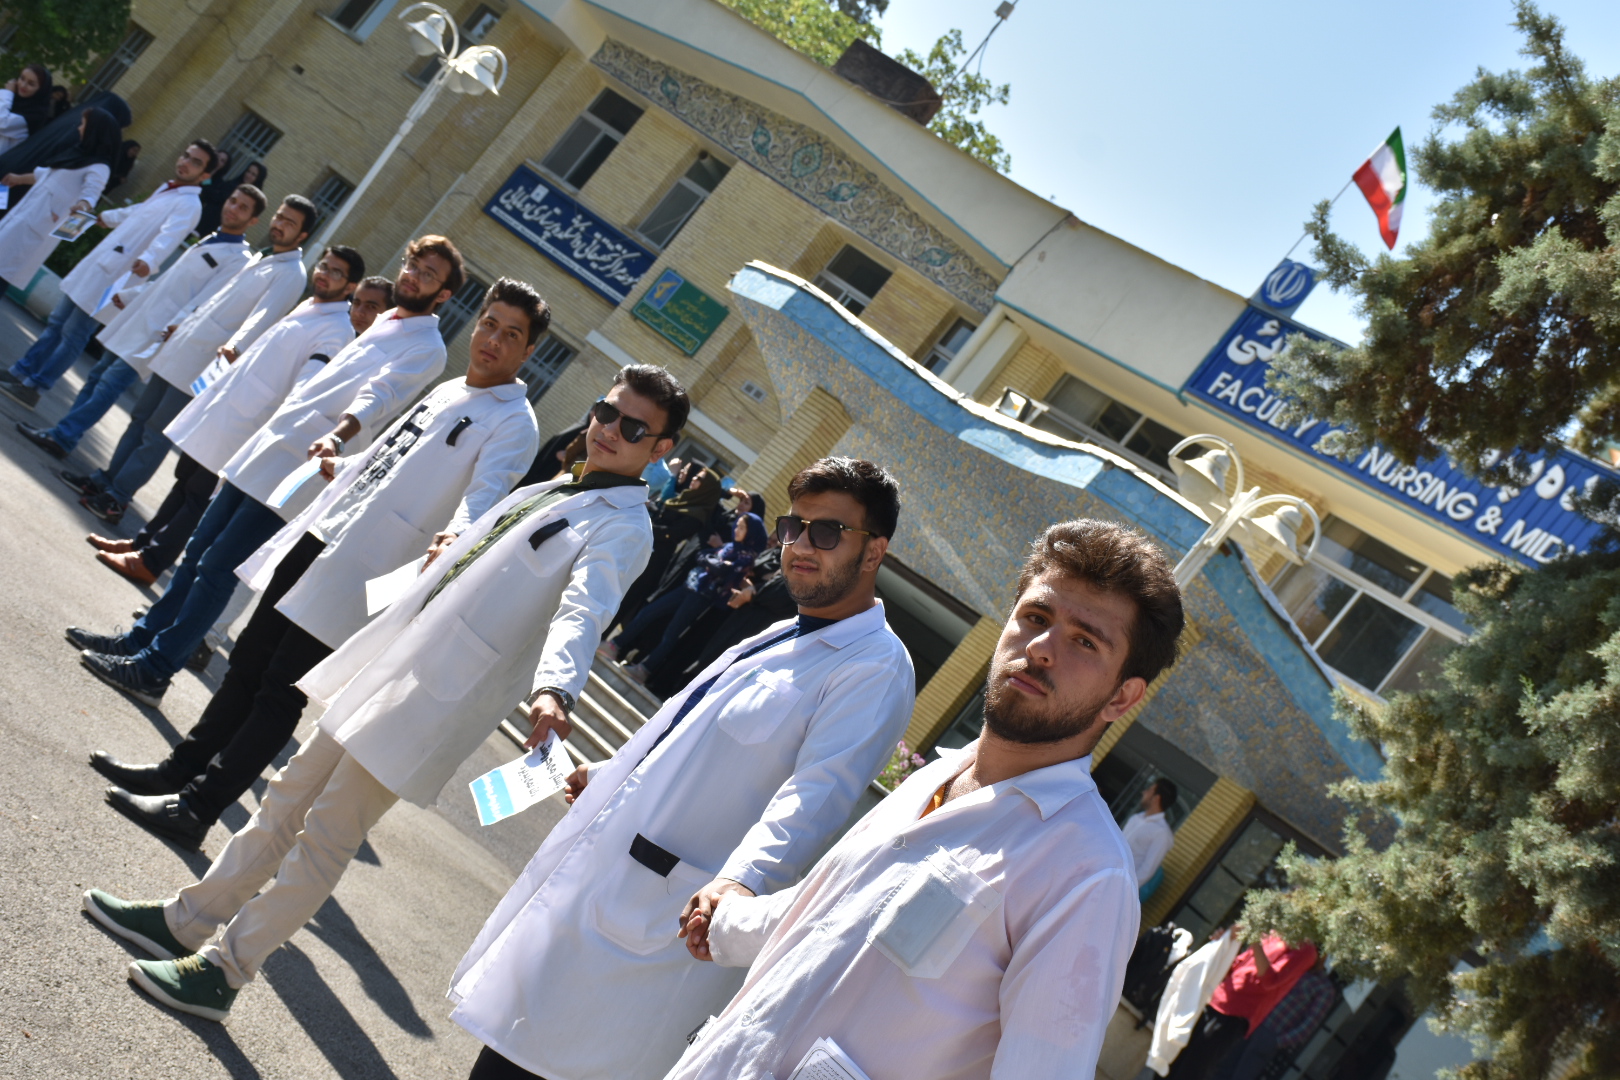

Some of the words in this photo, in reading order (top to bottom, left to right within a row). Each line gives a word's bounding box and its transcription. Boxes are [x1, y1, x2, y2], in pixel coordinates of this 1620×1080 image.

[1358, 446, 1479, 520] NURSING
[1475, 505, 1504, 535] &
[1501, 519, 1586, 563] MID
